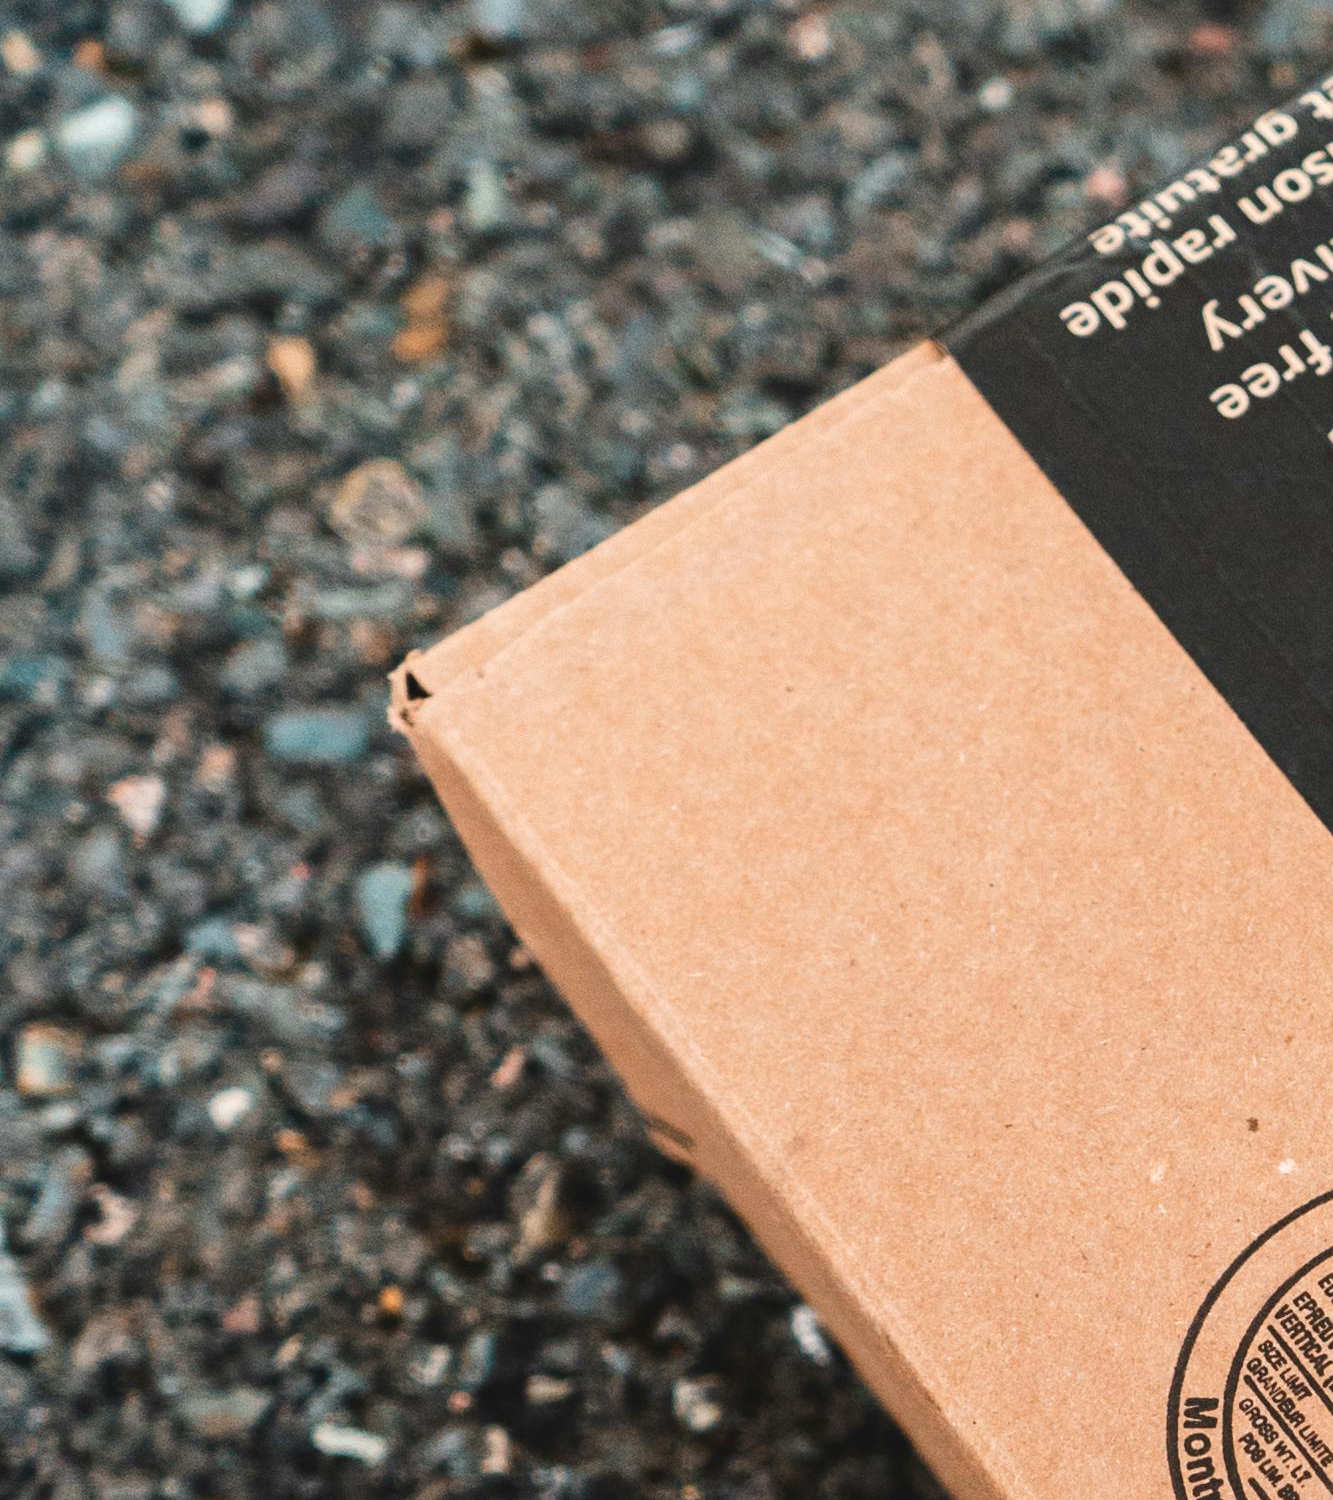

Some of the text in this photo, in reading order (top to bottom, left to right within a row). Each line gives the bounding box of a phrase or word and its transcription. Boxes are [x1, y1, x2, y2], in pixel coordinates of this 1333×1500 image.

[1088, 112, 1297, 253] gratuite
[1060, 216, 1236, 336] rapide
[1210, 330, 1332, 418] free
[1258, 1340, 1287, 1371] SIZE
[1280, 1368, 1312, 1401] LIMIT
[1275, 1304, 1333, 1377] VERTICAL
[1239, 1399, 1279, 1444] GROSS
